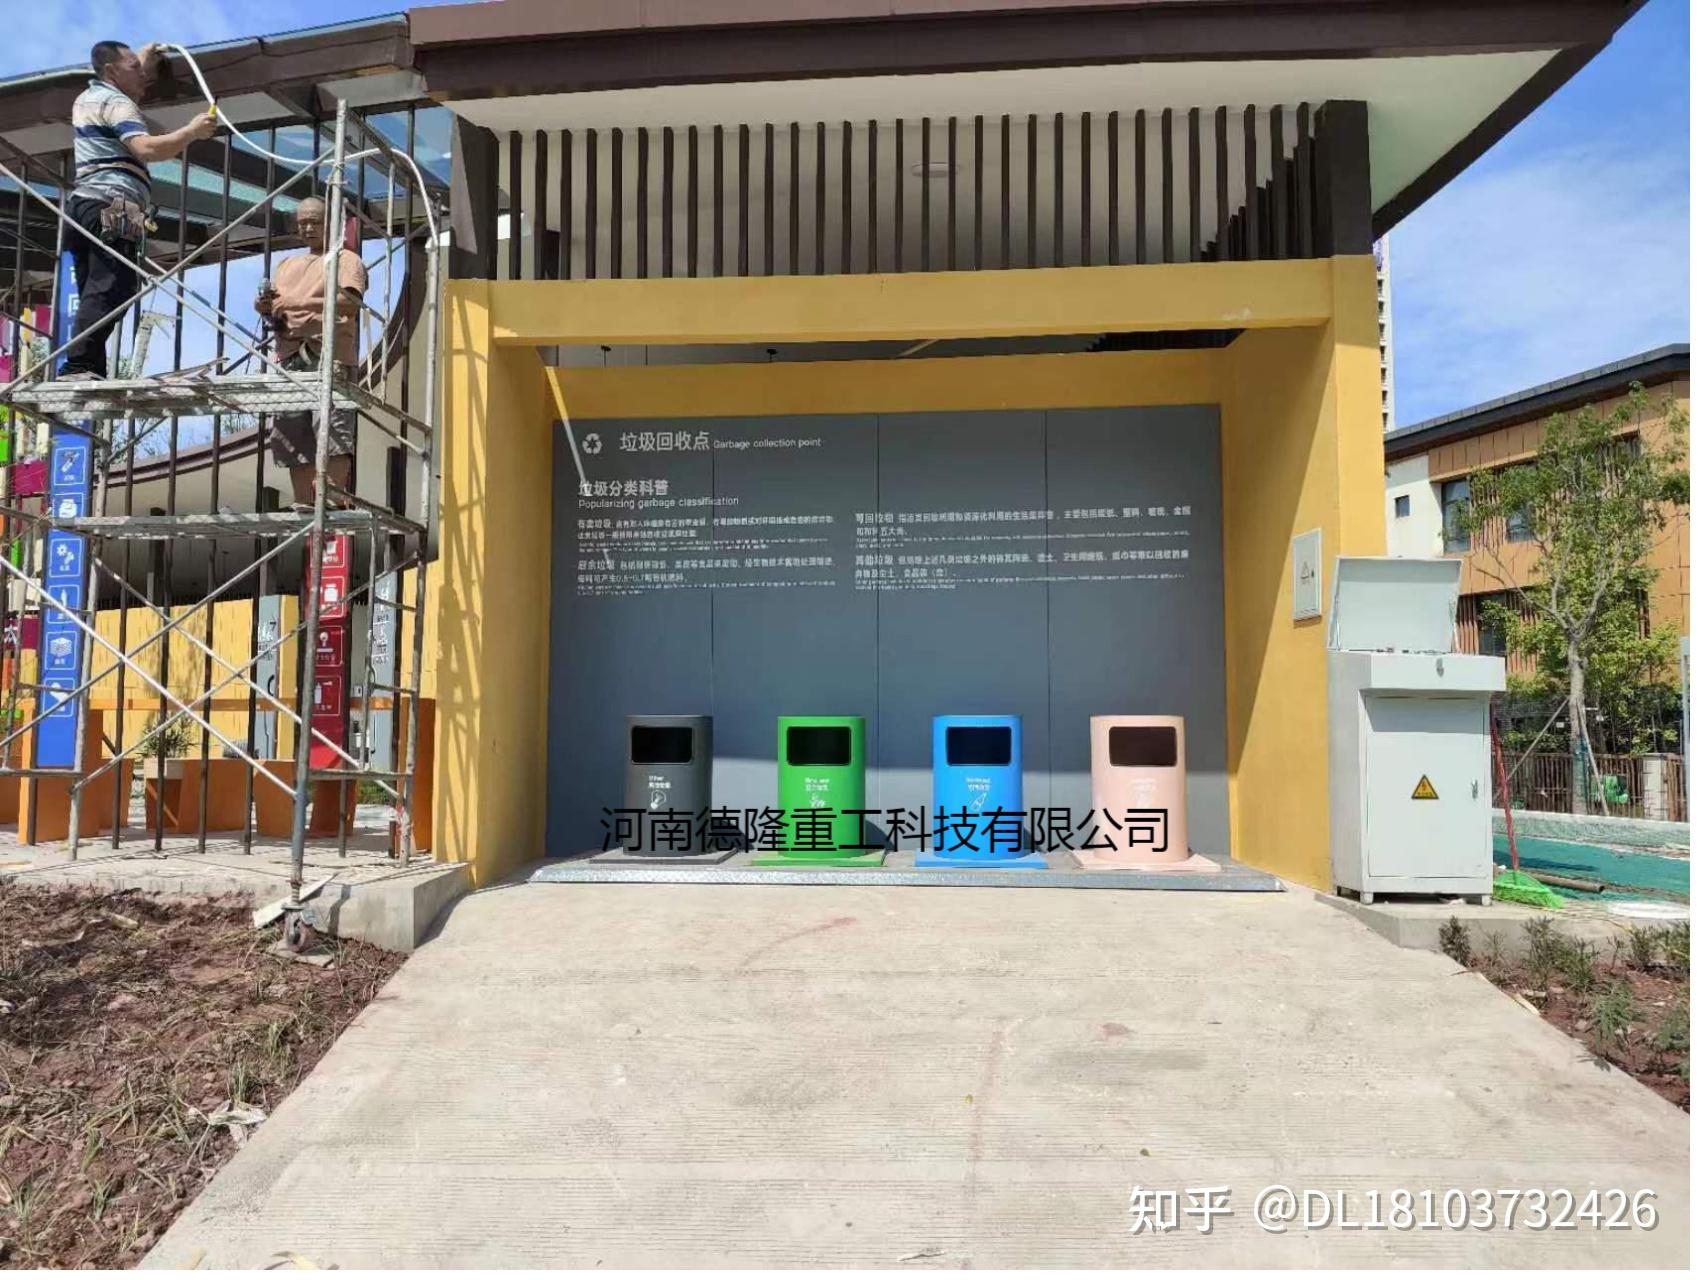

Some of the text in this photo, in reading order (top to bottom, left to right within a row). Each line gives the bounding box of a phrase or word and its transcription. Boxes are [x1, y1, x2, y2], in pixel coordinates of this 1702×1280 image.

[620, 431, 710, 452] 垃圾回收点
[713, 437, 821, 450] Garbage collection point
[578, 479, 669, 496] 垃圾分类科普
[578, 497, 739, 509] Popularizing garbage classification
